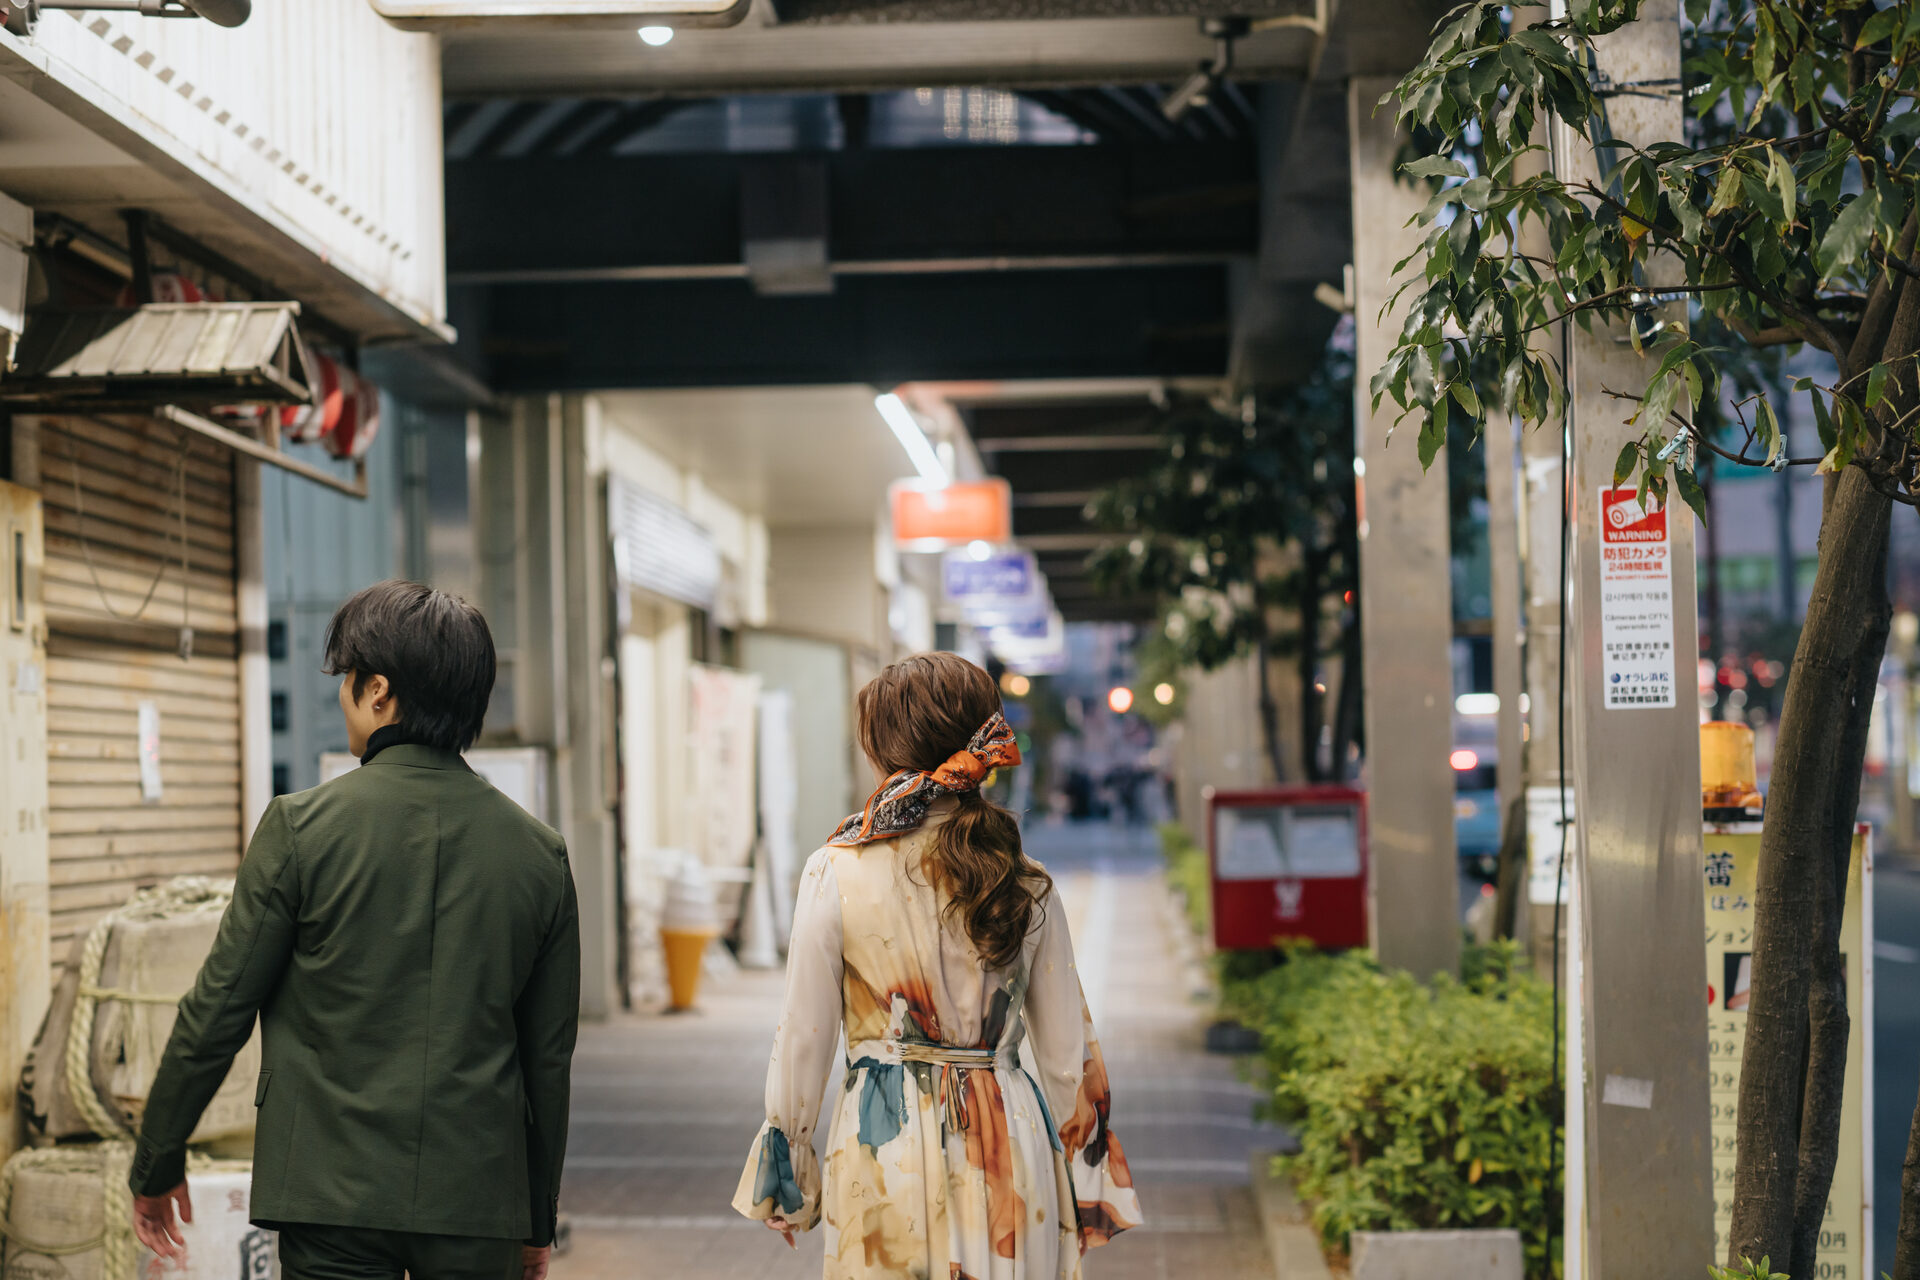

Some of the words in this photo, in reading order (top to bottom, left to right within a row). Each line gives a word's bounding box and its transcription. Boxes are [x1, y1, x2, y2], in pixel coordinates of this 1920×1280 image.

[1608, 530, 1663, 541] WARNING
[1604, 546, 1667, 560] 防犯カメラ
